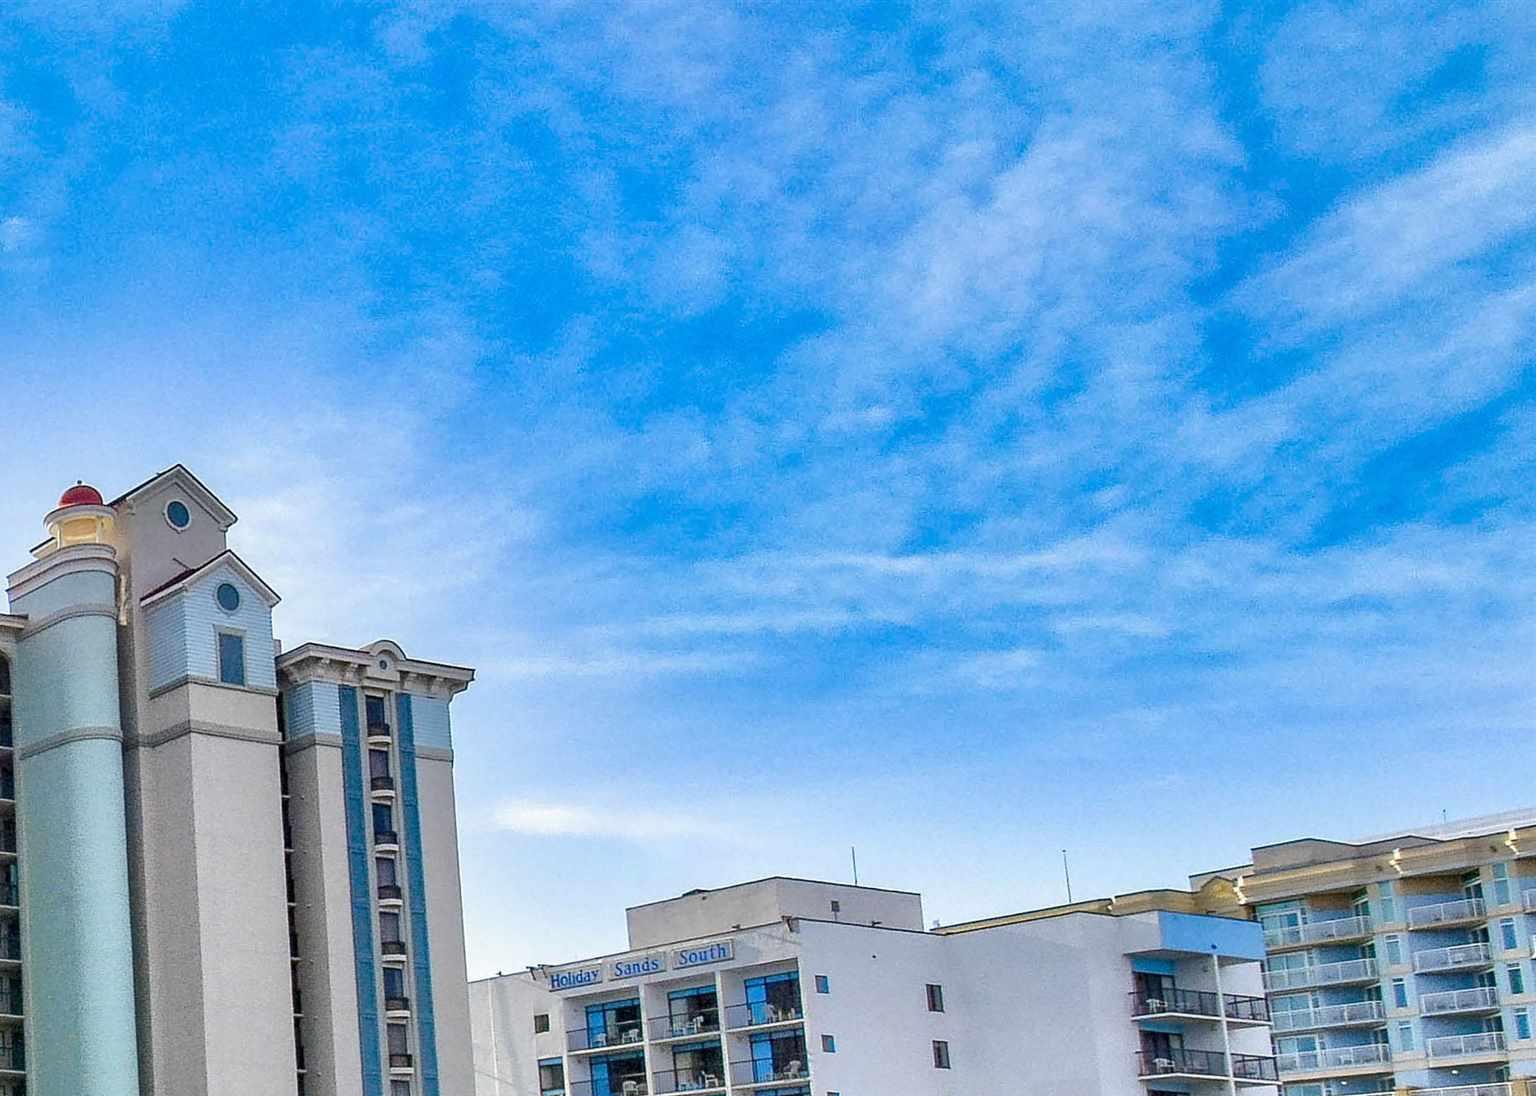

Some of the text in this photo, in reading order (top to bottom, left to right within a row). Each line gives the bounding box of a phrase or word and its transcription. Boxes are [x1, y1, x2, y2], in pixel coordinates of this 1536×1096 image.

[550, 943, 727, 989] Holiday Sands South
